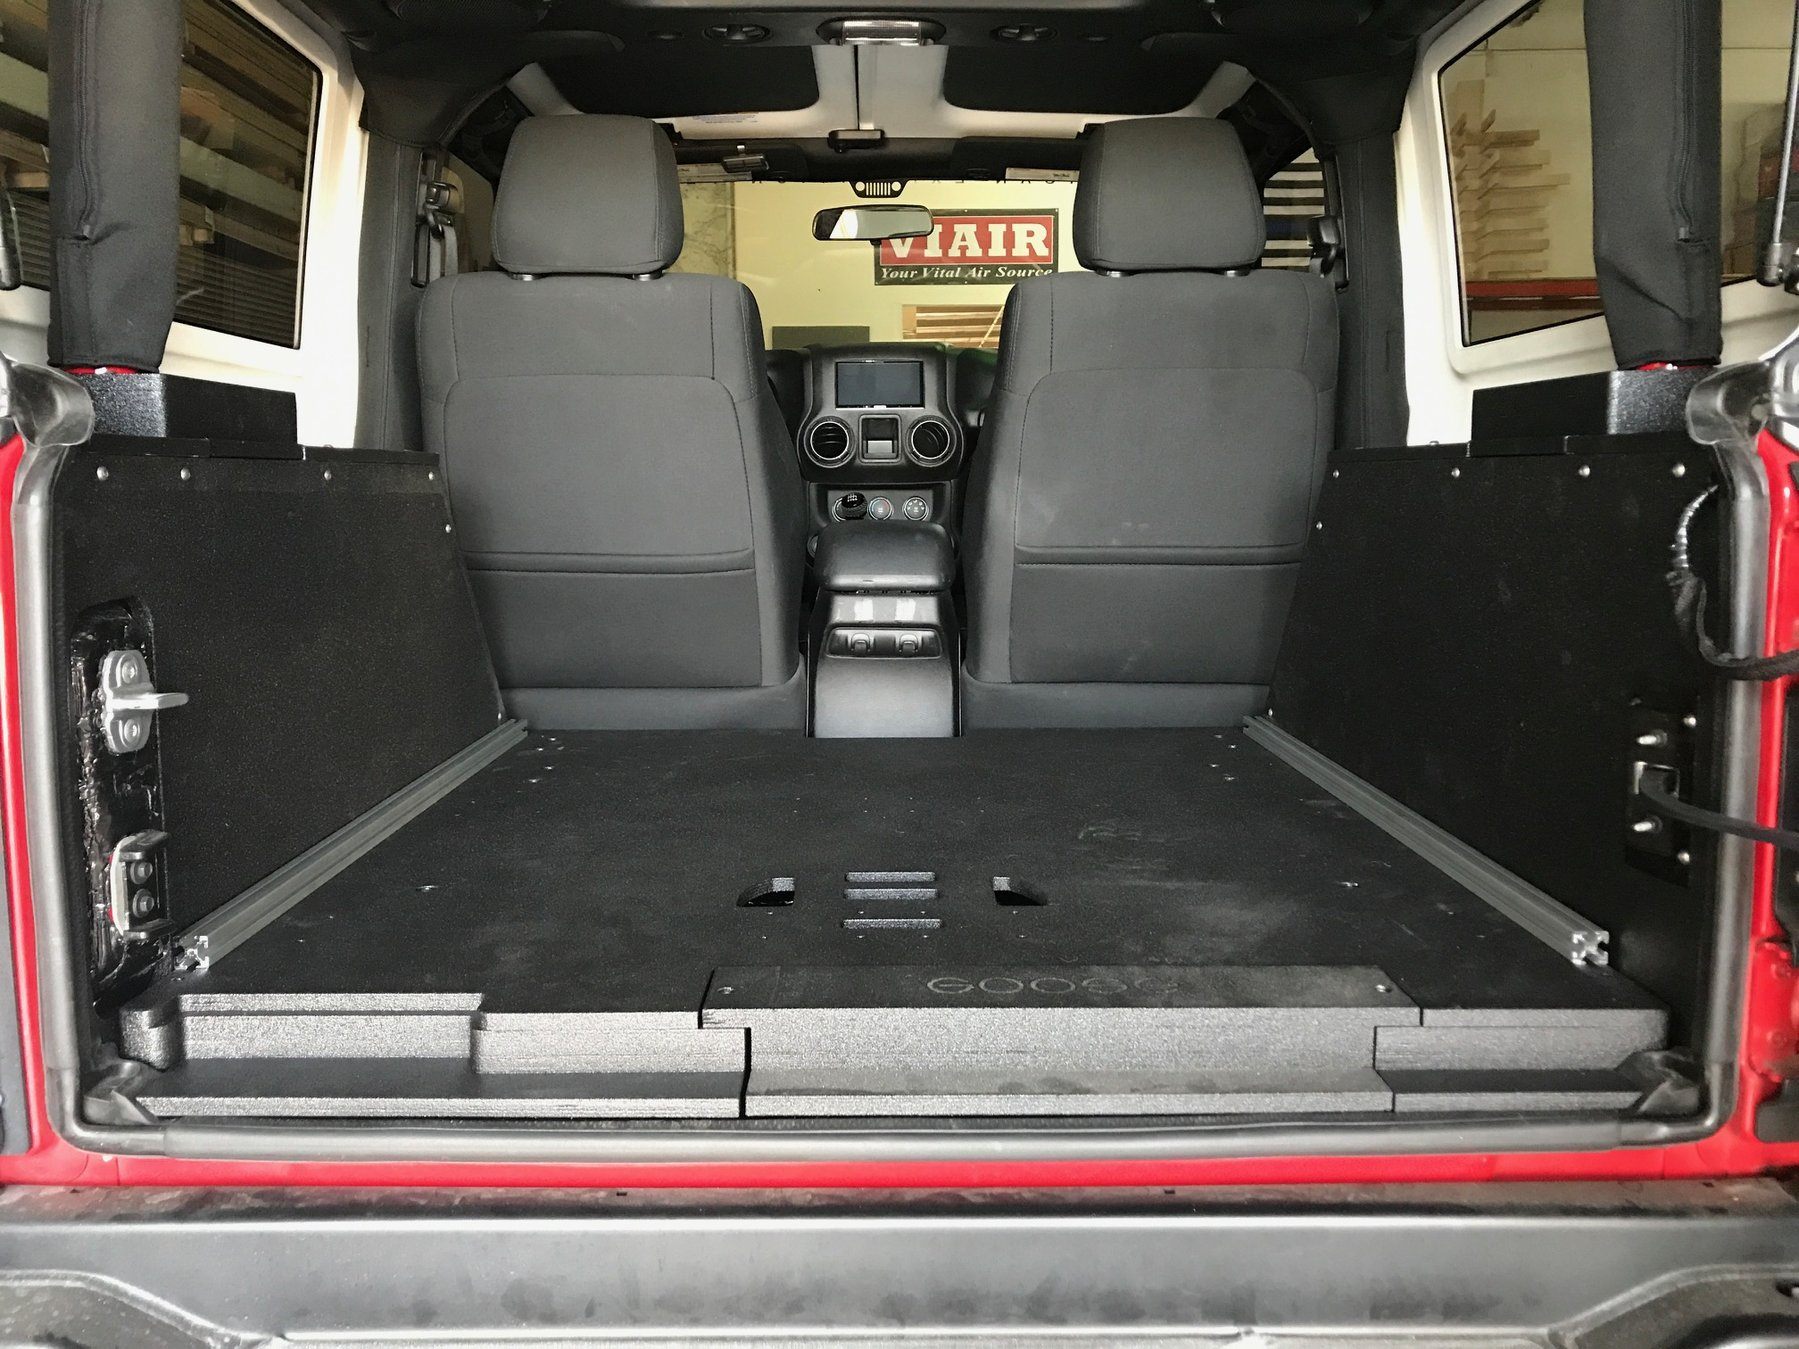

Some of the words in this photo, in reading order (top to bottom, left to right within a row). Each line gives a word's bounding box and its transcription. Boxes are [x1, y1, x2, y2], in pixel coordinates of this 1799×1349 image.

[889, 223, 1050, 258] VIAIR
[881, 268, 918, 279] Your
[922, 267, 961, 278] Vital
[964, 267, 991, 278] Air
[995, 266, 1053, 278] Source
